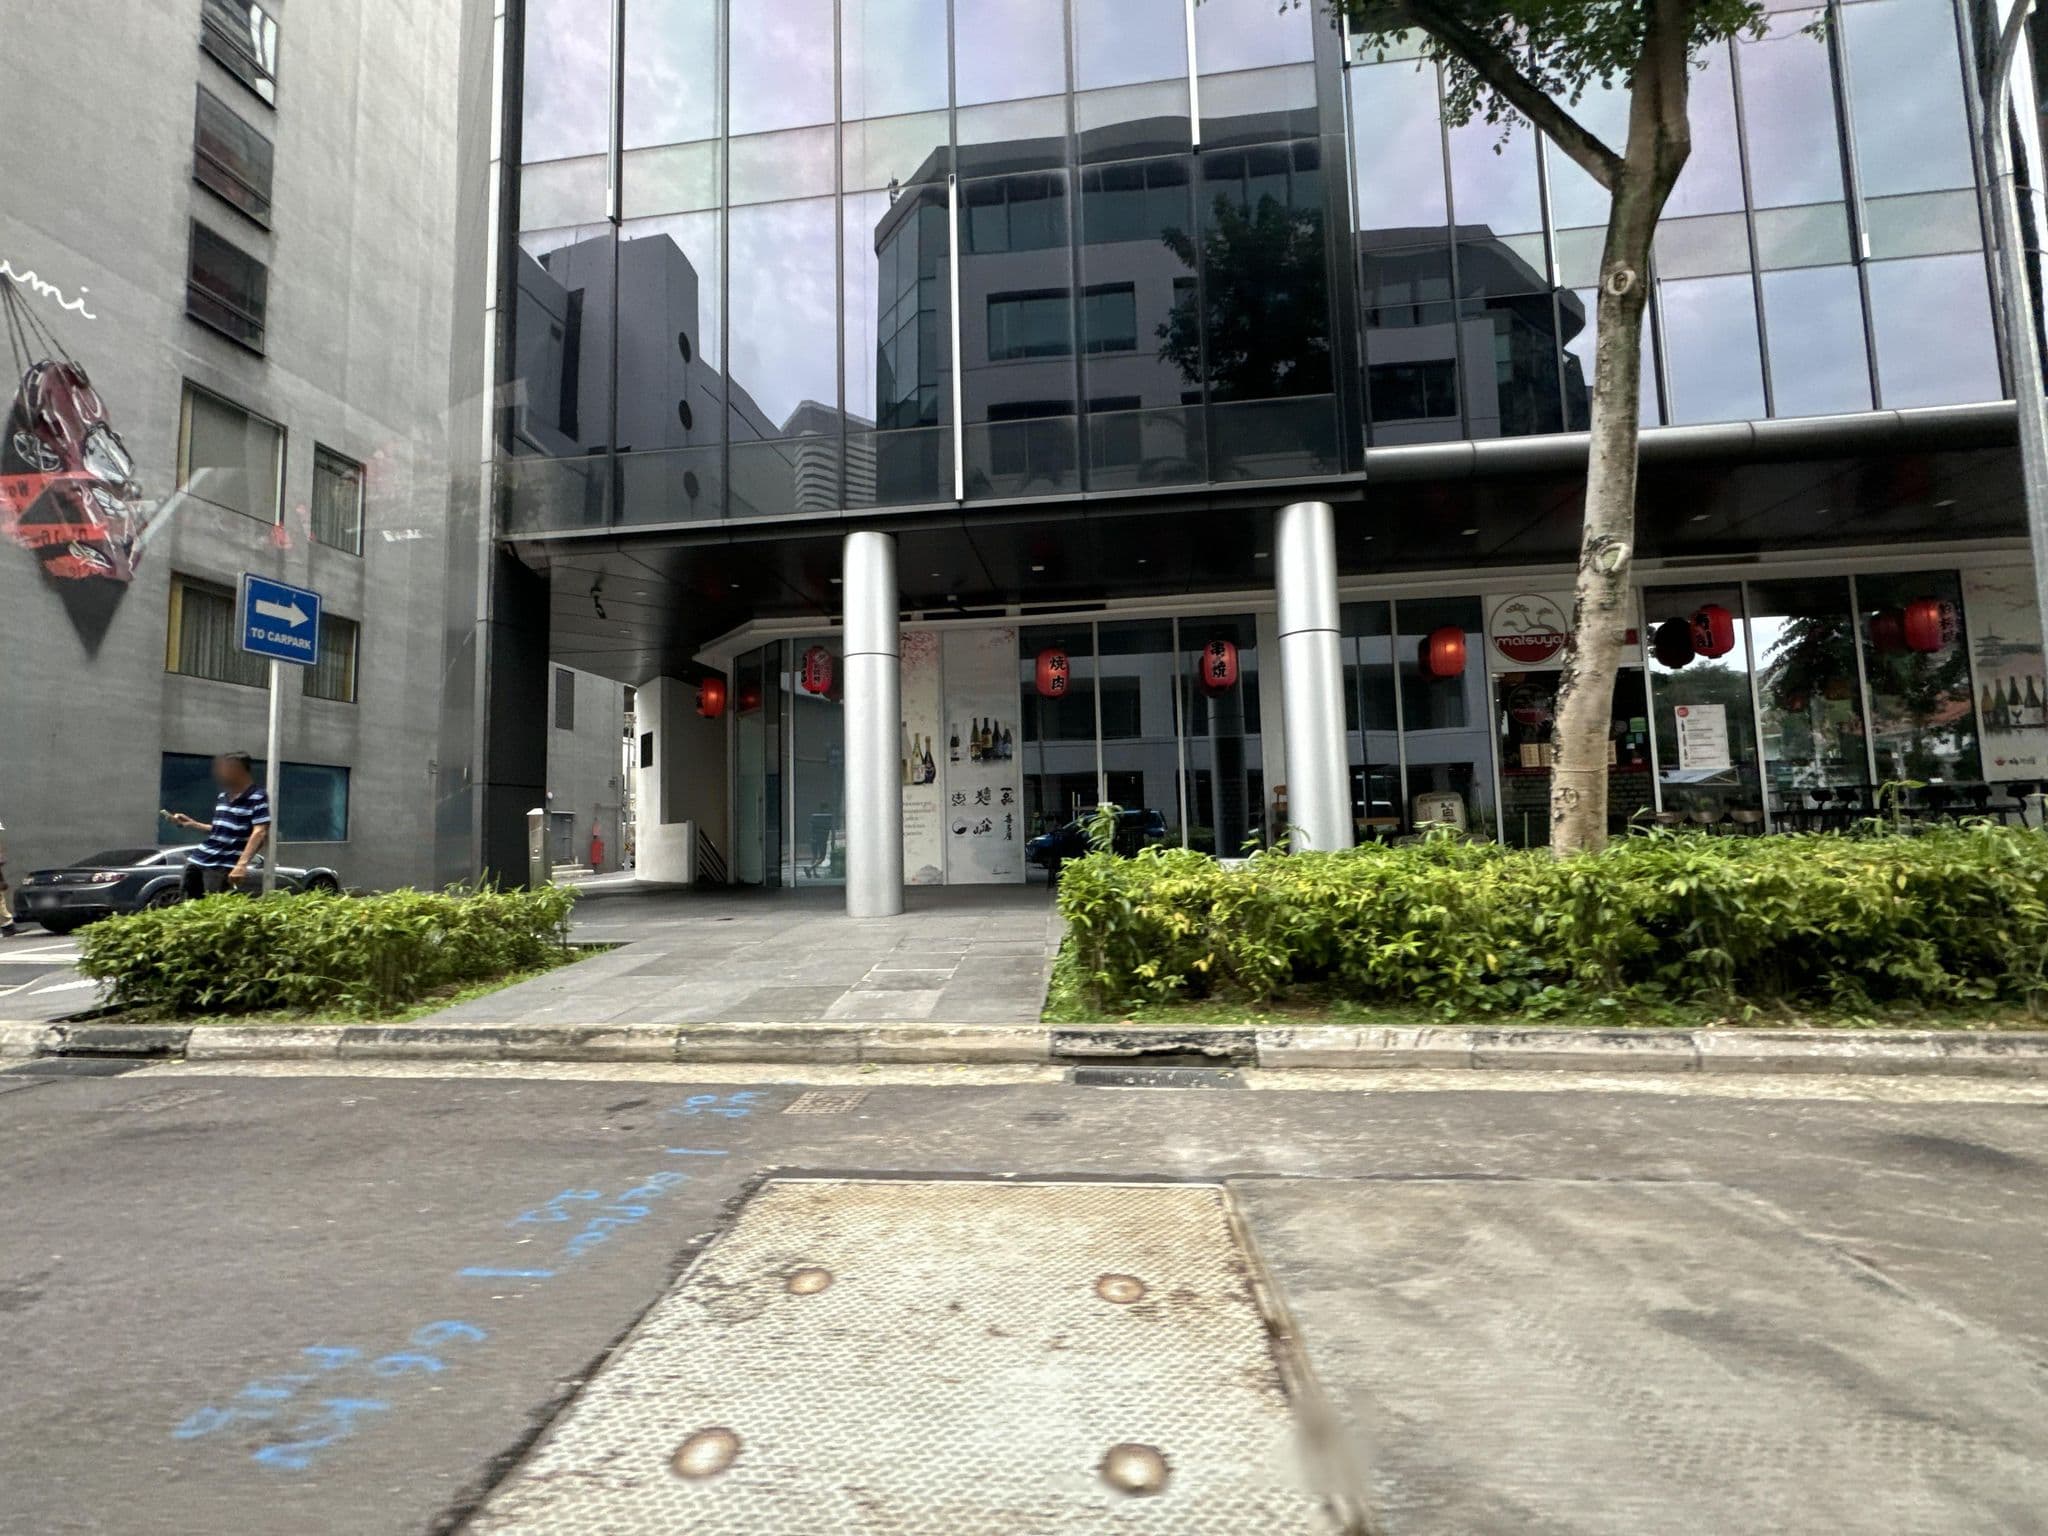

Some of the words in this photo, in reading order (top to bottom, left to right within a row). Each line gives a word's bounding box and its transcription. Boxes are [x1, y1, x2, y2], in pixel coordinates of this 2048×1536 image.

[251, 627, 265, 640] TO
[267, 631, 312, 651] CARPARK
[1496, 632, 1563, 648] matsuya
[1049, 655, 1066, 690] 焼肉
